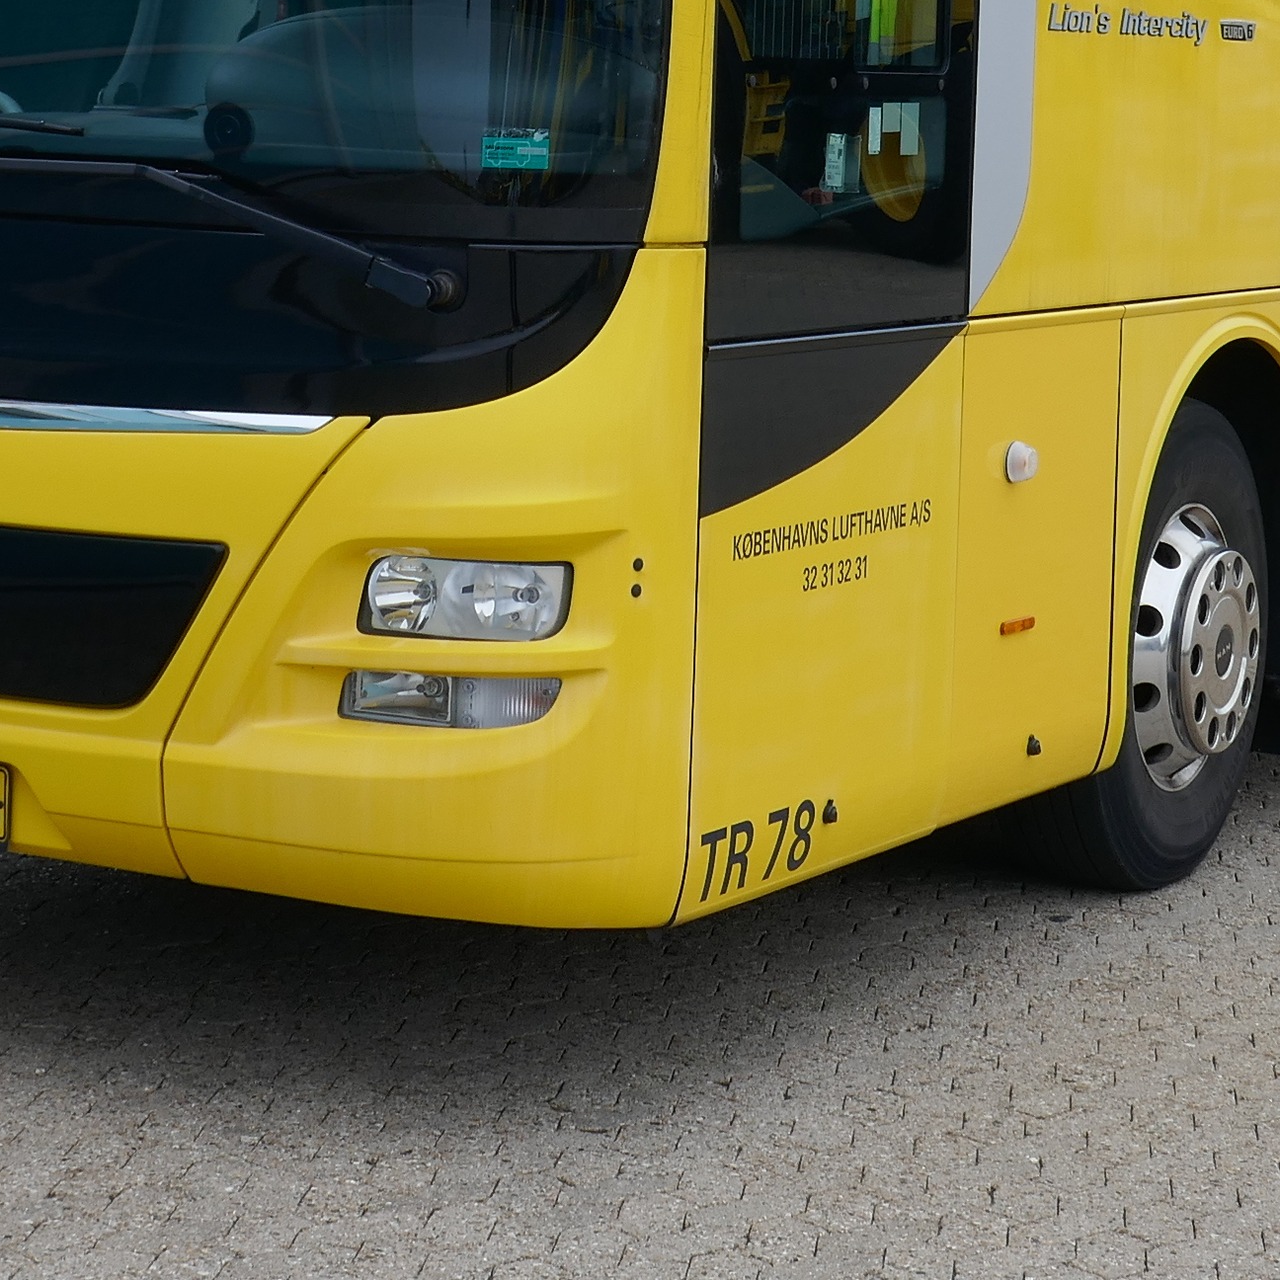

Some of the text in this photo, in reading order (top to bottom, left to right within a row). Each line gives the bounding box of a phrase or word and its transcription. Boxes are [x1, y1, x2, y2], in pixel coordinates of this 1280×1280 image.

[1048, 2, 1209, 46] Lion's Intercity
[1223, 25, 1244, 40] EURO
[732, 498, 932, 562] KØBENHAVNS LUFTHAVNE A/S
[802, 554, 869, 592] 32 31 32 31
[700, 799, 815, 903] TR 78
